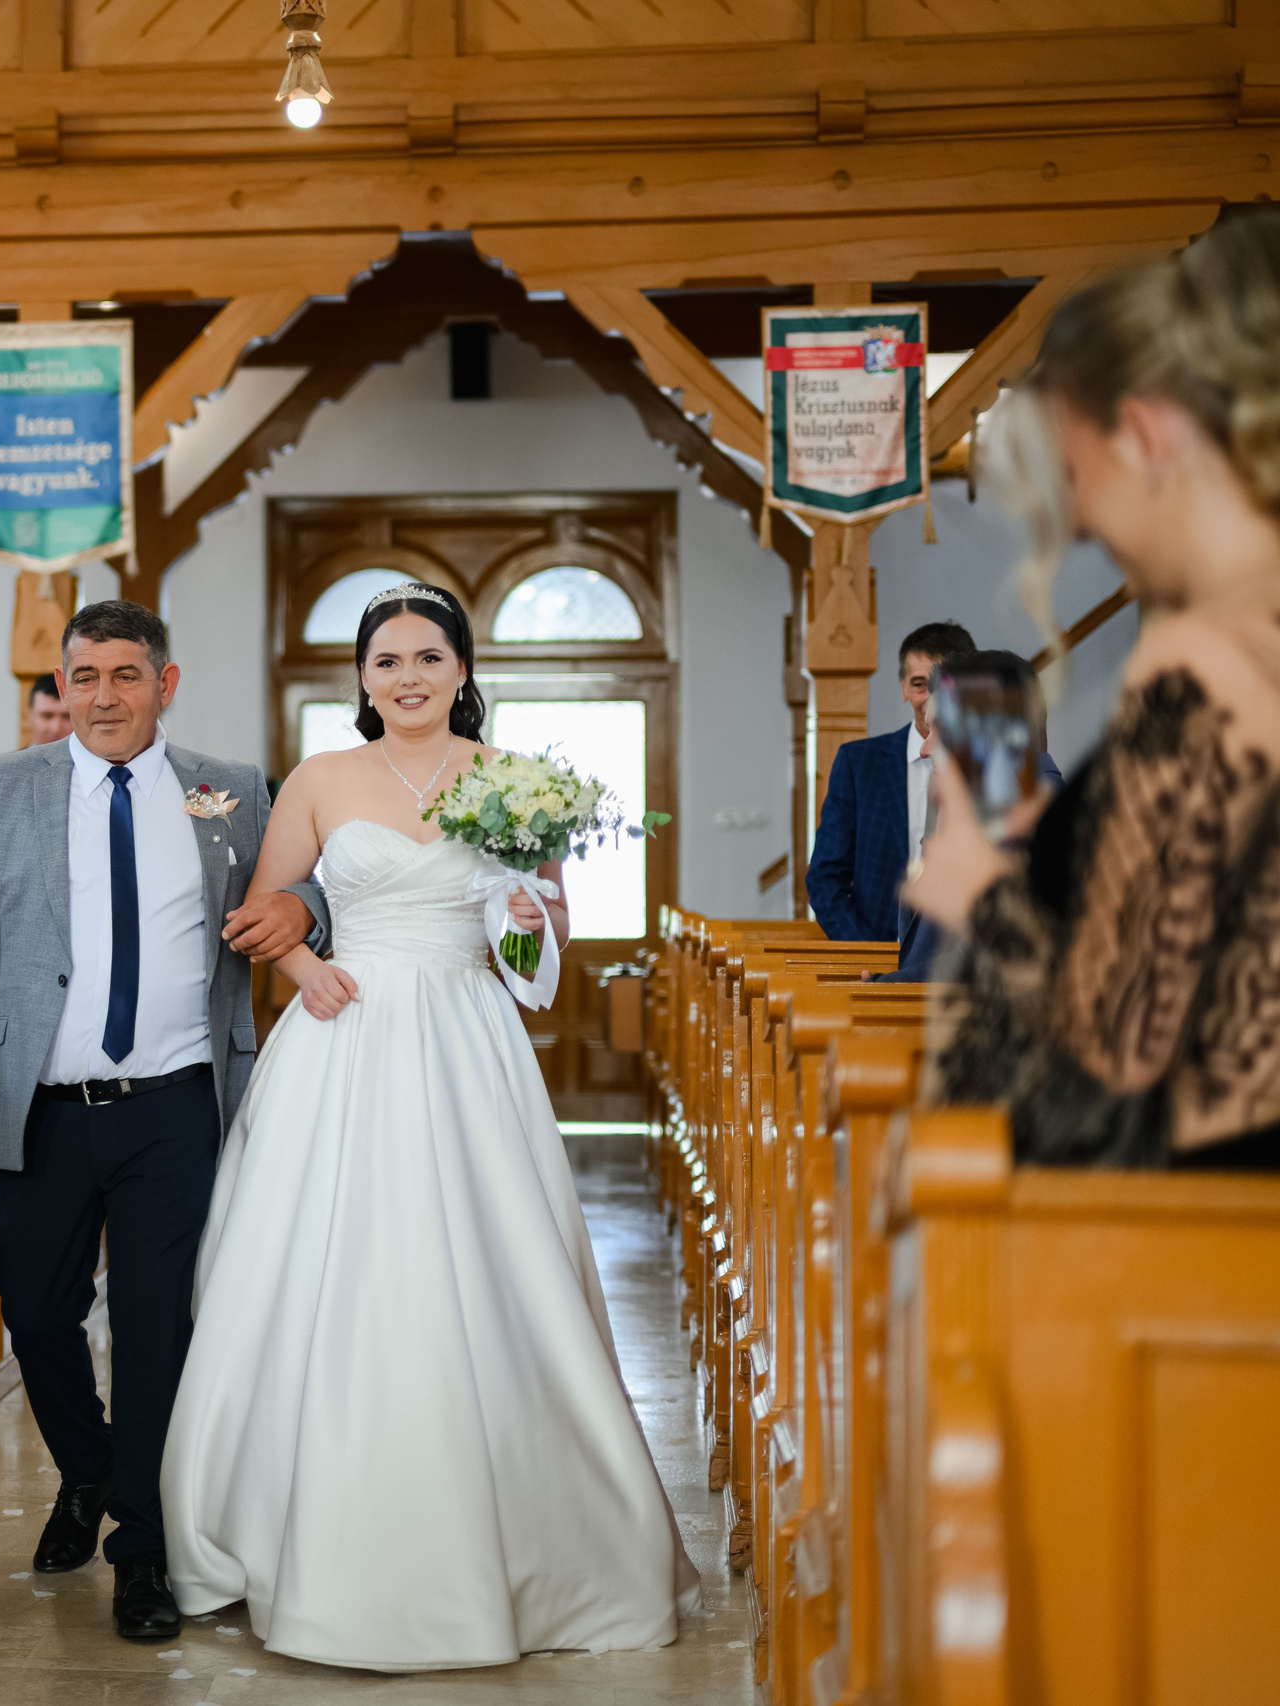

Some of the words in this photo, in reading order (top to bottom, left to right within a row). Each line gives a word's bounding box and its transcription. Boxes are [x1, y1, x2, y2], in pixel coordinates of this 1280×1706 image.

[793, 375, 840, 394] Jézus
[794, 396, 899, 415] Krisztusnak
[16, 415, 74, 436] Isten
[794, 441, 856, 463] vagyok
